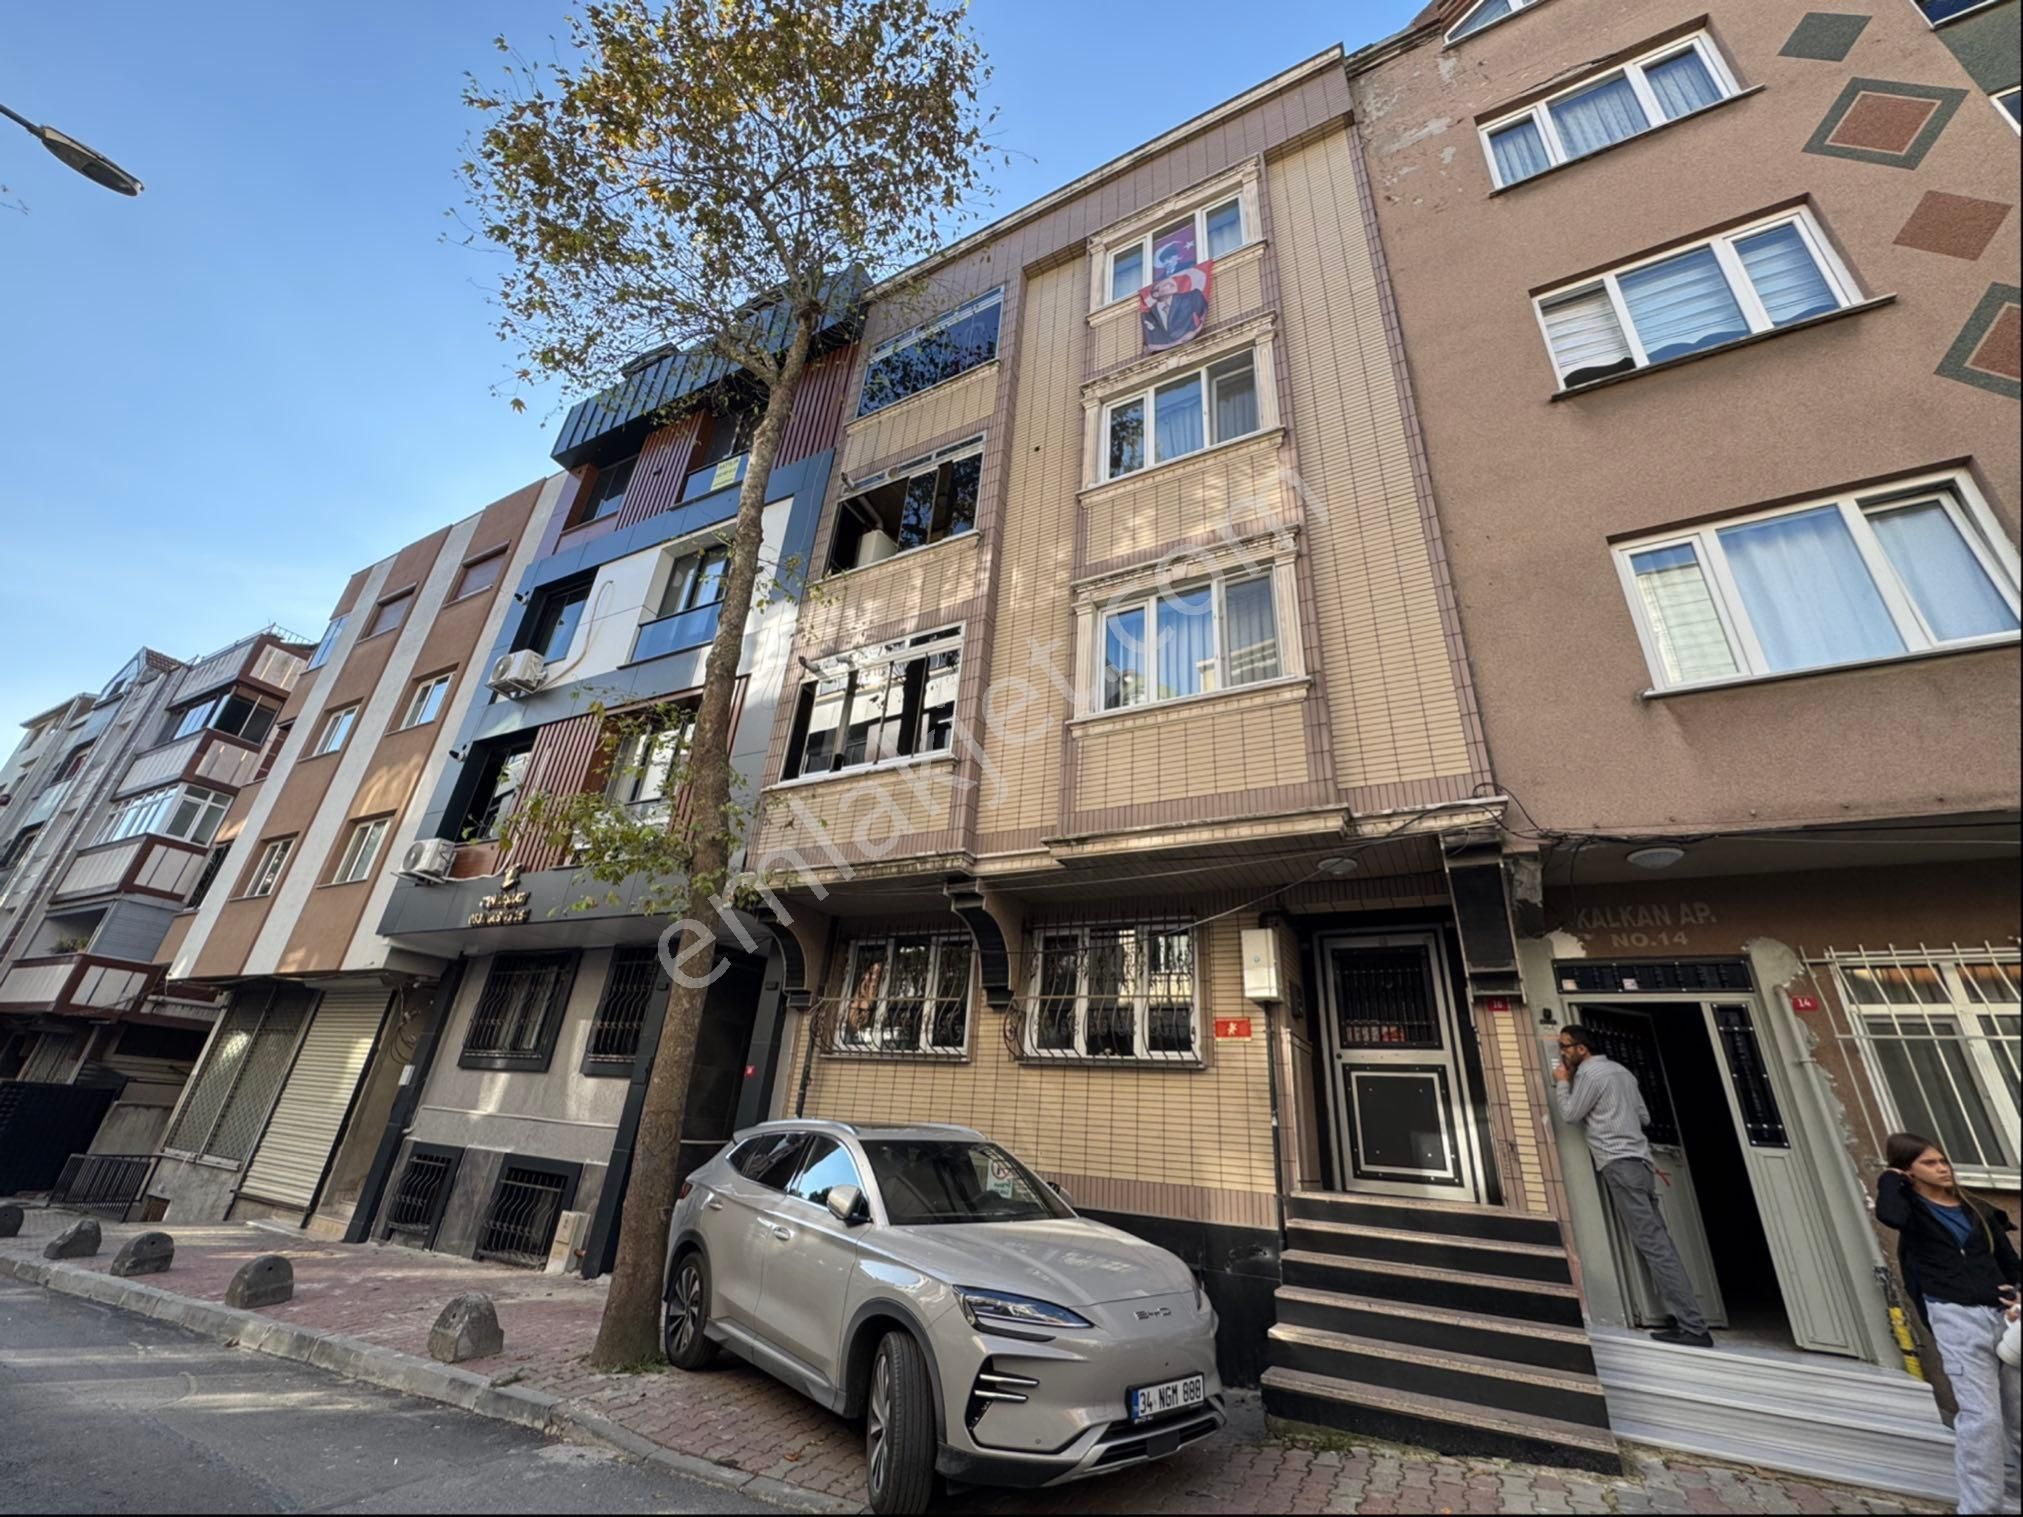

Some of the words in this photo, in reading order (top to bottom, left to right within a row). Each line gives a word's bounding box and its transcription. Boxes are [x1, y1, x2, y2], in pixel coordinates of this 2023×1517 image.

[1577, 903, 1672, 928] KALKAN
[1679, 901, 1717, 926] AP.
[1609, 931, 1688, 947] NO.14
[1797, 998, 1811, 1008] 14
[1140, 1391, 1153, 1413] 34
[1158, 1384, 1179, 1409] NGM
[1183, 1379, 1201, 1402] 888
